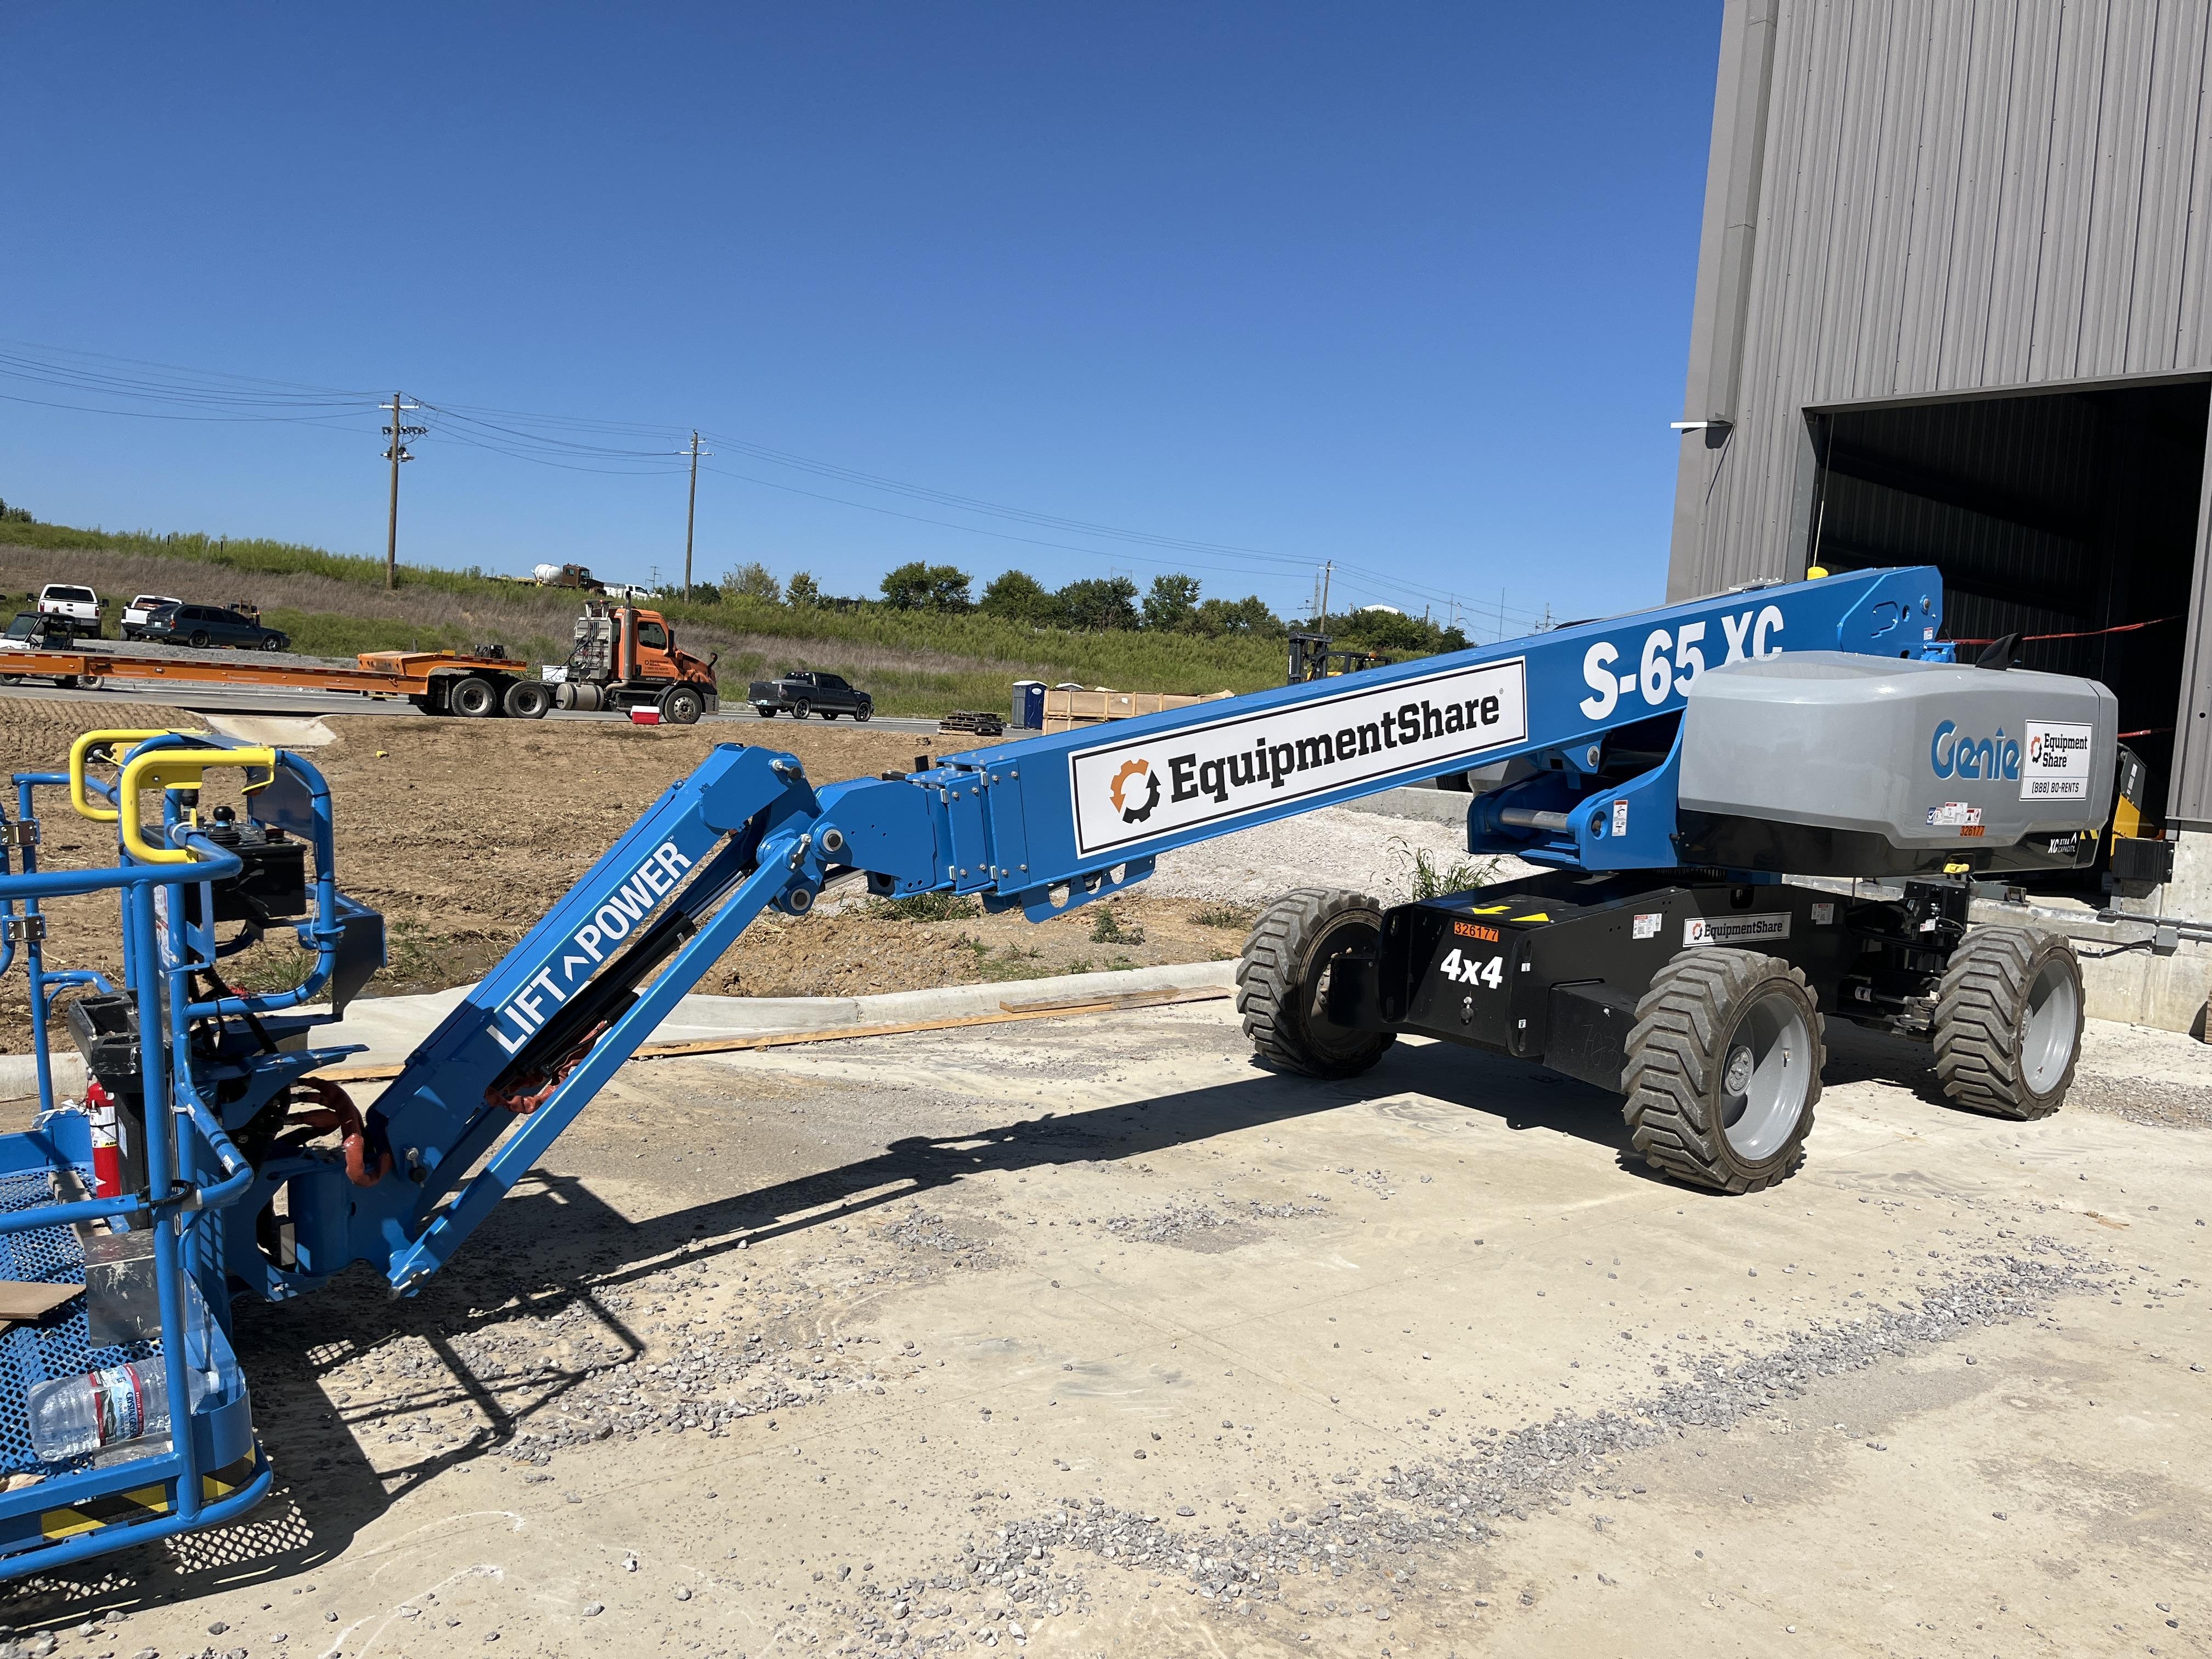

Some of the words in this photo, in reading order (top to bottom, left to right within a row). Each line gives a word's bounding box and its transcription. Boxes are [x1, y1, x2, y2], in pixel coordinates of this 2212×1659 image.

[1579, 620, 1706, 720] S-65
[1720, 605, 1784, 667] XC
[1167, 695, 1500, 804] EquipmentShare
[1931, 719, 2022, 782] Genie
[2044, 732, 2088, 752] Equipment
[2042, 752, 2067, 768] Share
[2032, 781, 2050, 794] (888)
[2051, 782, 2079, 793] 80-RENTS
[1960, 825, 1985, 837] 326177
[2047, 838, 2059, 854] XC
[1455, 922, 1498, 941] 326177
[1703, 921, 1783, 940] EquipmentShare
[486, 966, 567, 1054] LIFT
[573, 842, 692, 963] POWER
[1440, 948, 1503, 990] 4x4
[126, 1392, 136, 1418] CRYSTAL
